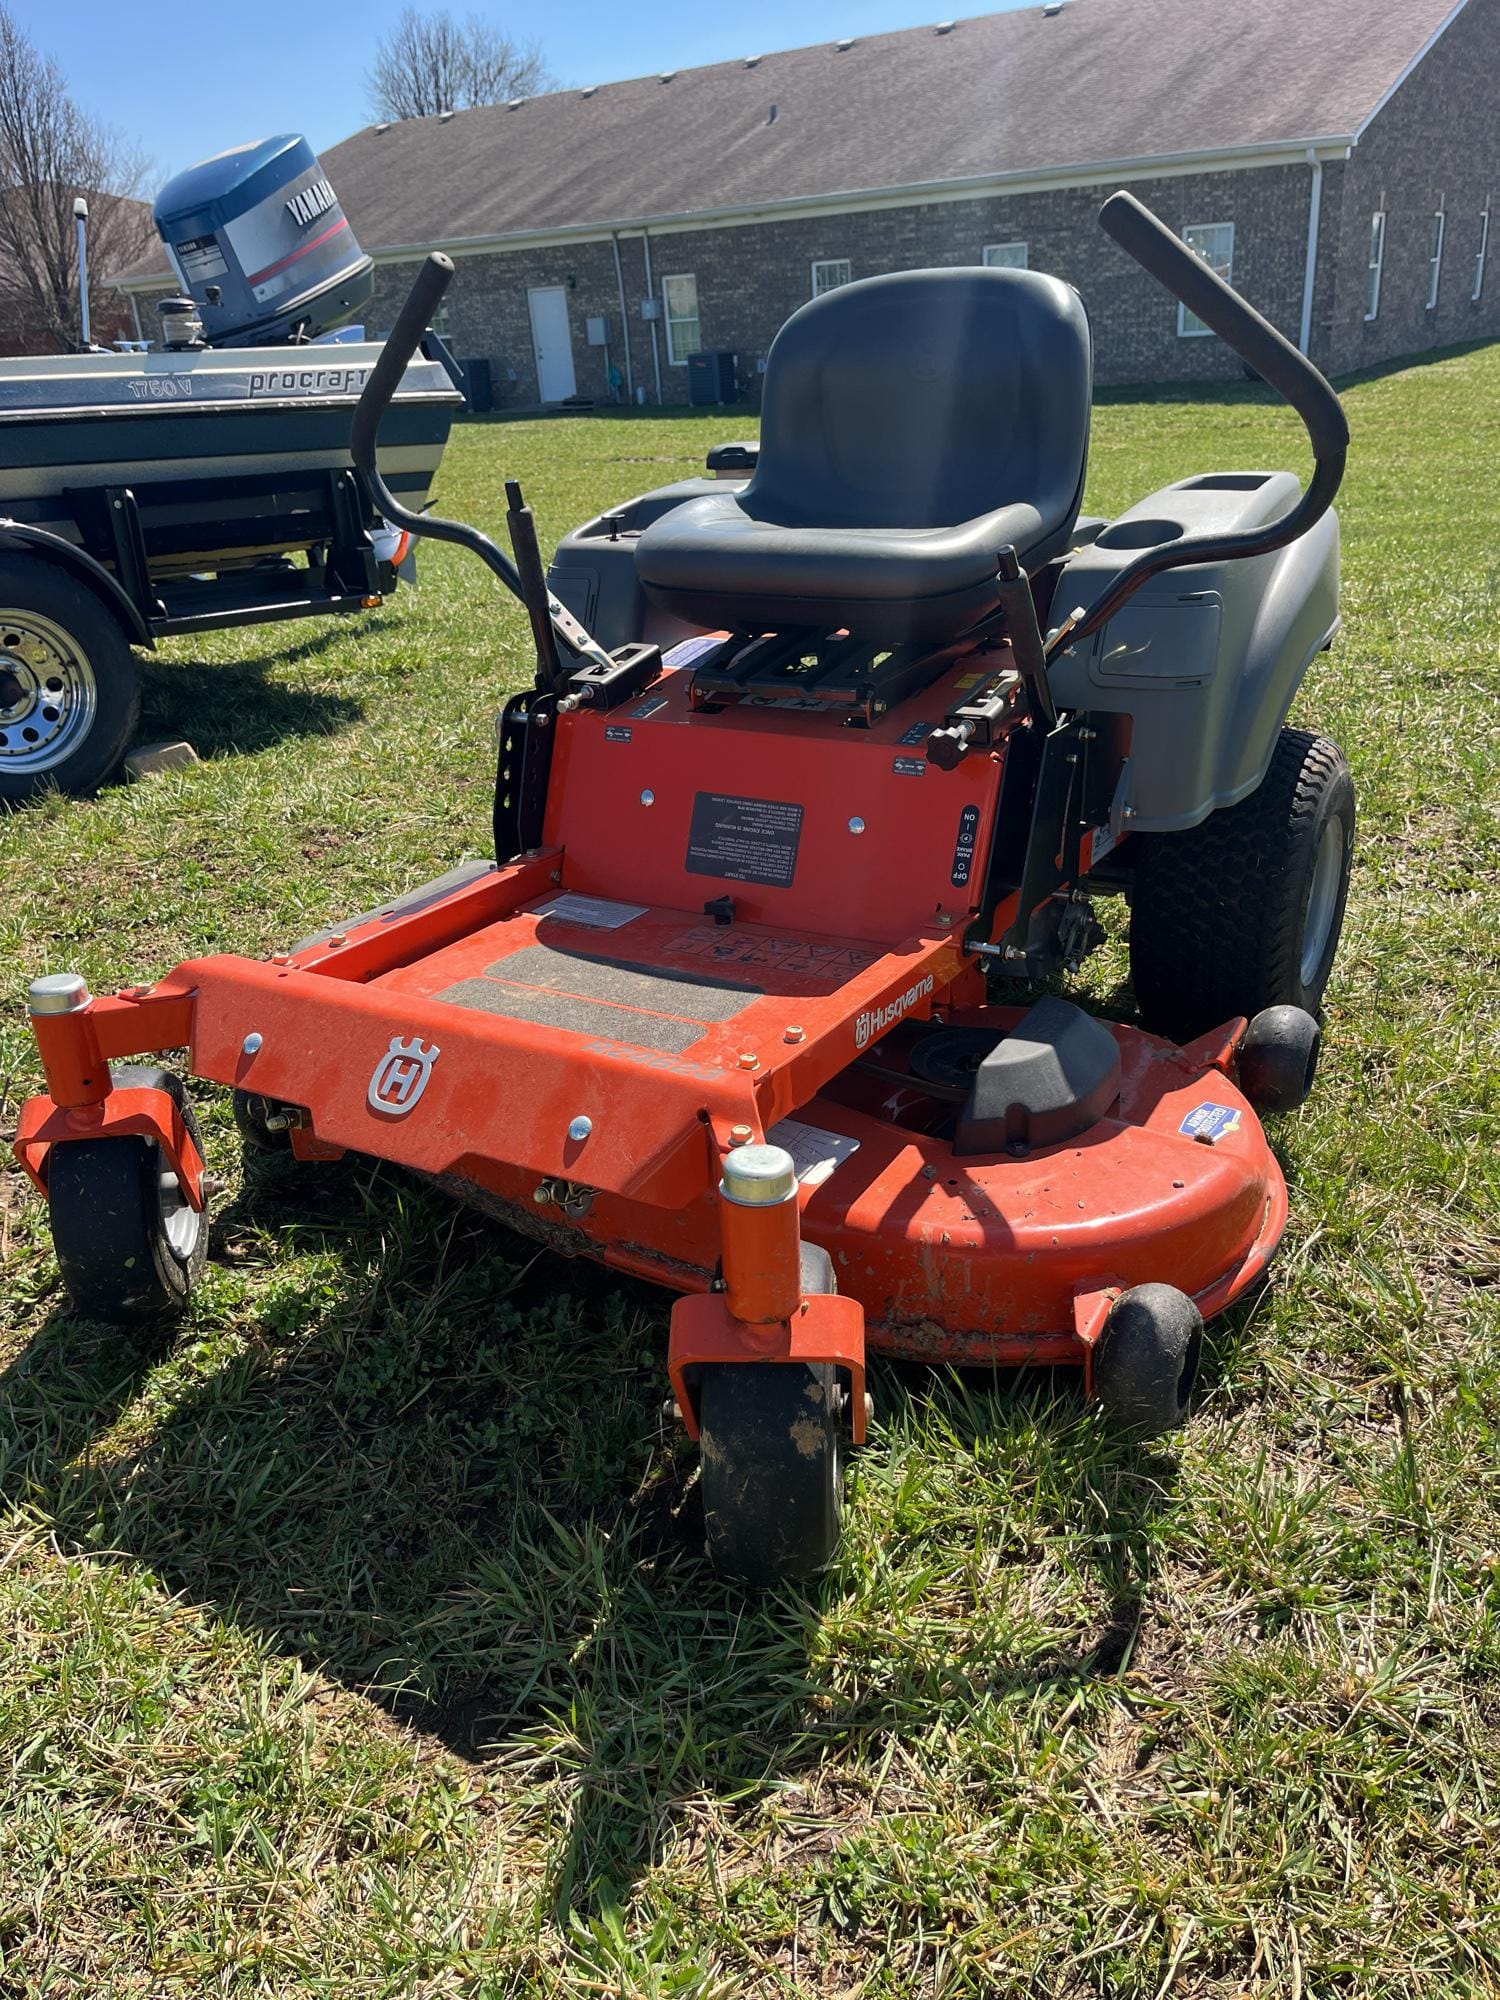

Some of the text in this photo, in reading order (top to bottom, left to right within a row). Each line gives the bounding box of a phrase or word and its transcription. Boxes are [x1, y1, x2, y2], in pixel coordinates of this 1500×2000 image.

[286, 180, 338, 226] YAMAHA
[127, 378, 192, 398] 1750 V
[964, 813, 976, 821] ON
[952, 872, 968, 880] OFF
[870, 974, 934, 1036] Husqvarna
